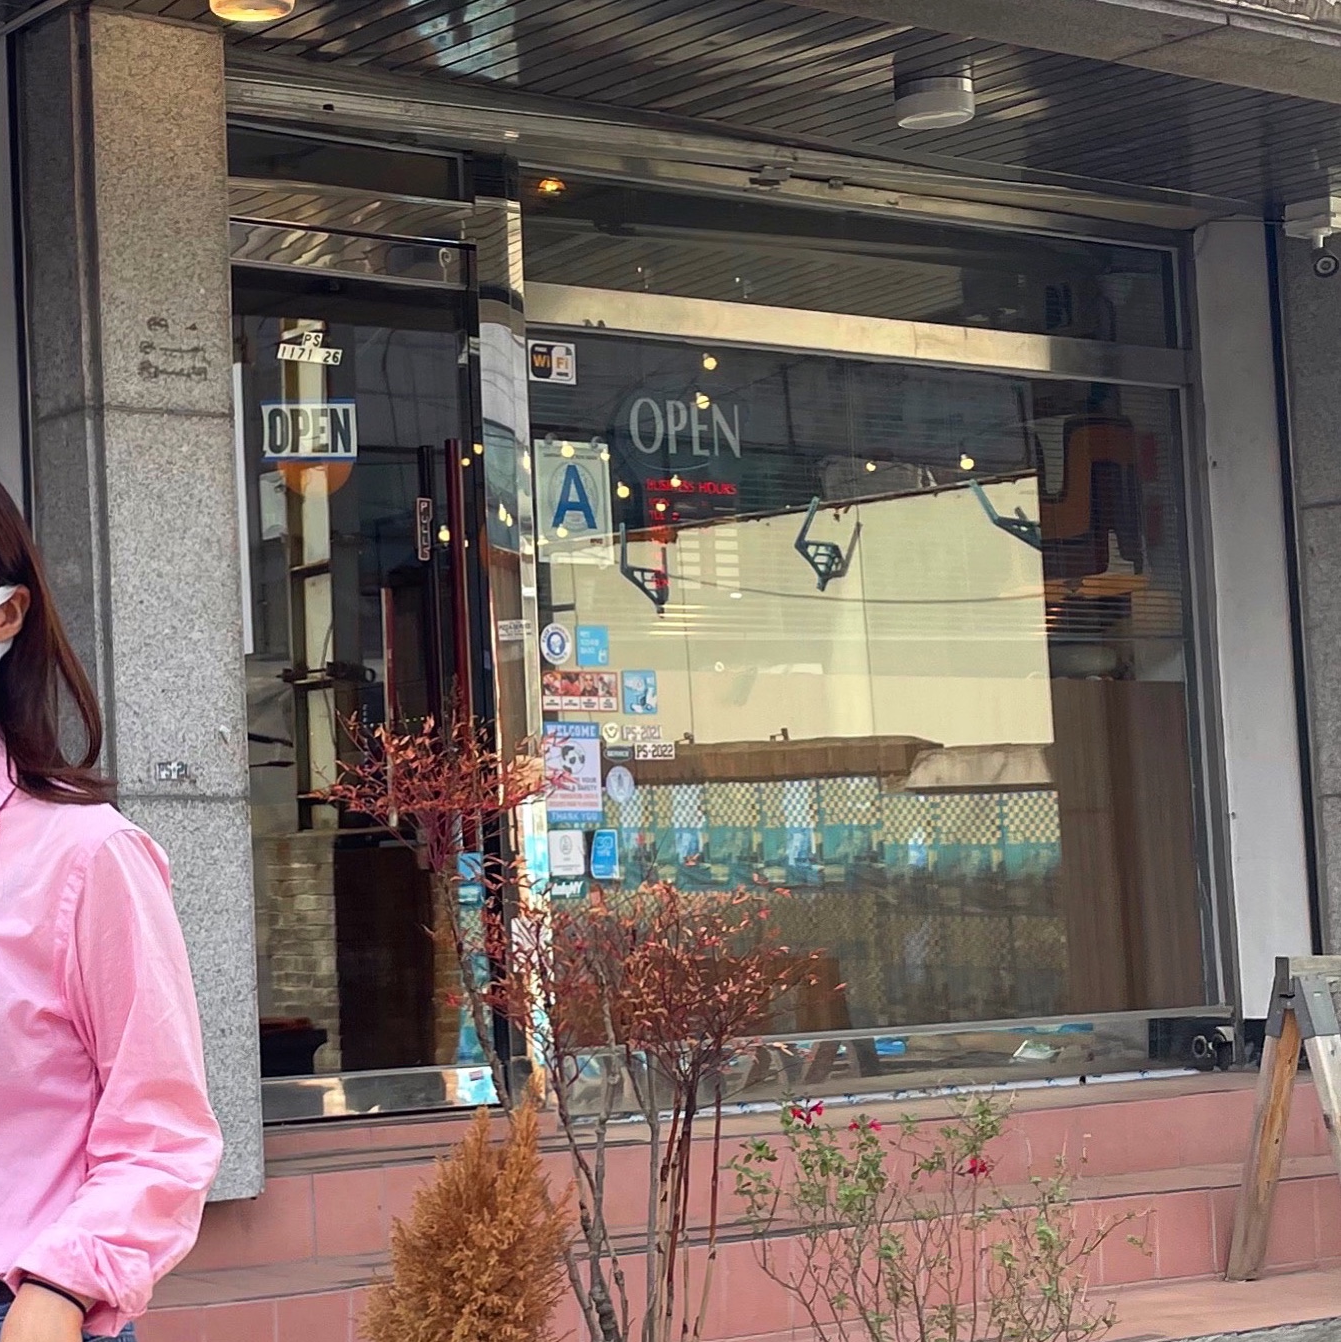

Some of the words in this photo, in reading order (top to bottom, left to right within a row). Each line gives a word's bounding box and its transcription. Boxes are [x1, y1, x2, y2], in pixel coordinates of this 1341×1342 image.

[302, 333, 322, 348] PS
[322, 351, 340, 364] 26
[268, 408, 352, 454] OPEN
[630, 397, 742, 458] OPEN
[699, 482, 738, 495] HOURS
[551, 464, 598, 530] A
[546, 724, 596, 737] WELCOME
